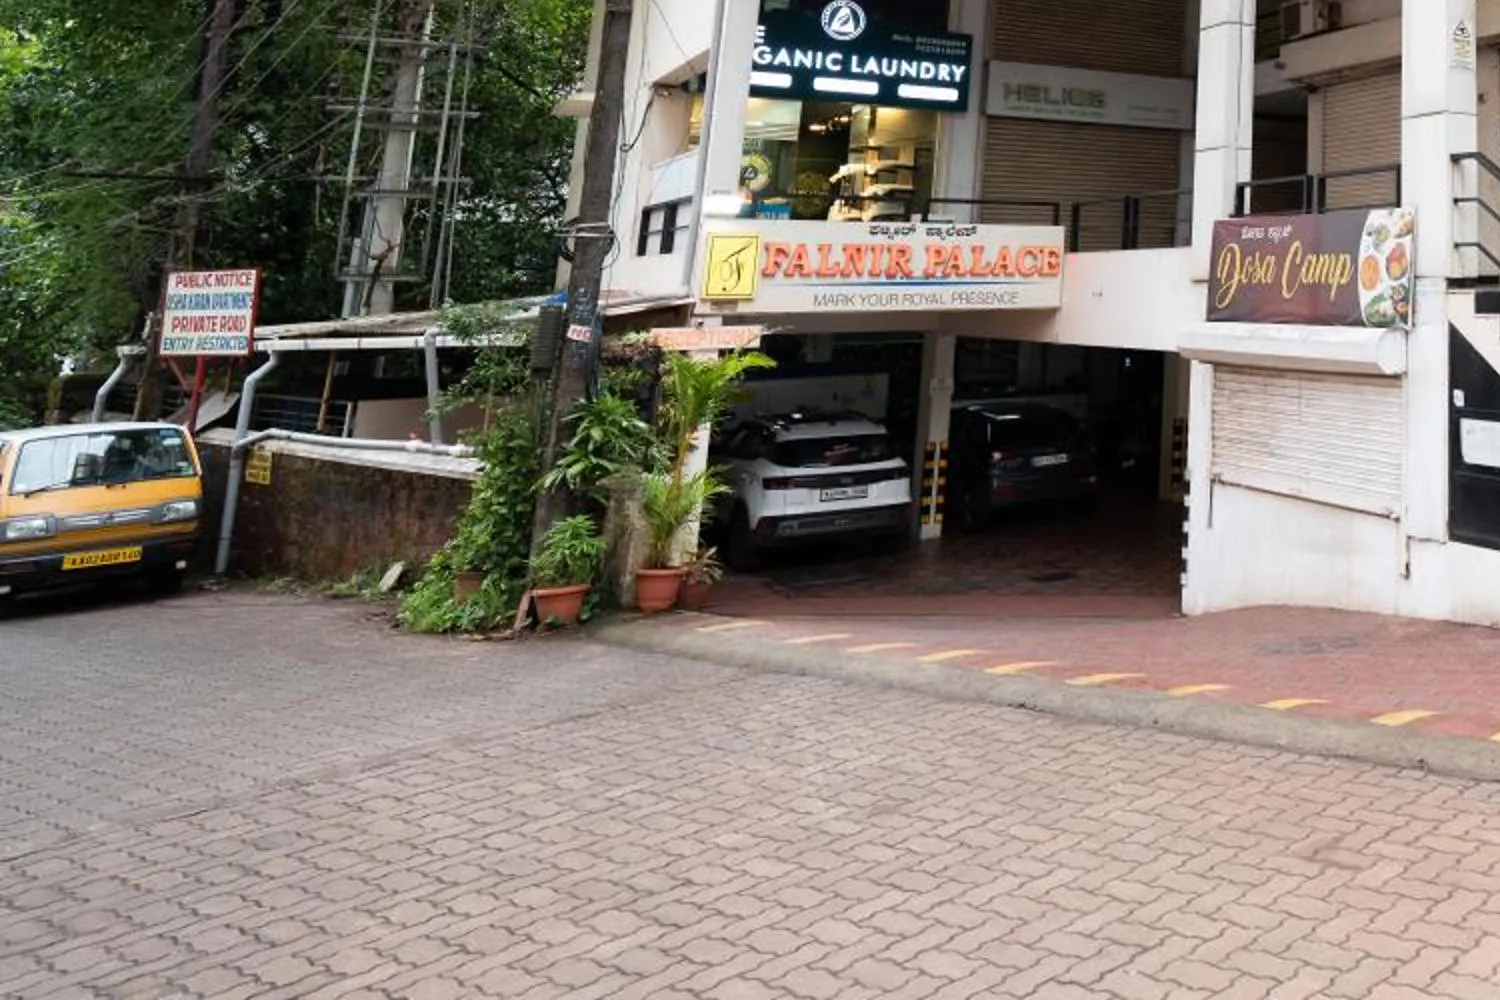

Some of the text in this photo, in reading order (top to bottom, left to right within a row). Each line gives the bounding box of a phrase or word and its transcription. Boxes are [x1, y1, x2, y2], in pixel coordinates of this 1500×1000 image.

[753, 45, 966, 83] GANIC LAUNDRY
[762, 241, 1061, 279] FALNIR PALACE
[175, 271, 252, 289] PUBLIC NOTICE
[1216, 240, 1354, 309] Dosa Camp
[813, 291, 1021, 307] MARK YOUR ROYAL PRESENCE
[171, 315, 219, 333] PRIVATE
[163, 336, 195, 351] ENTRY
